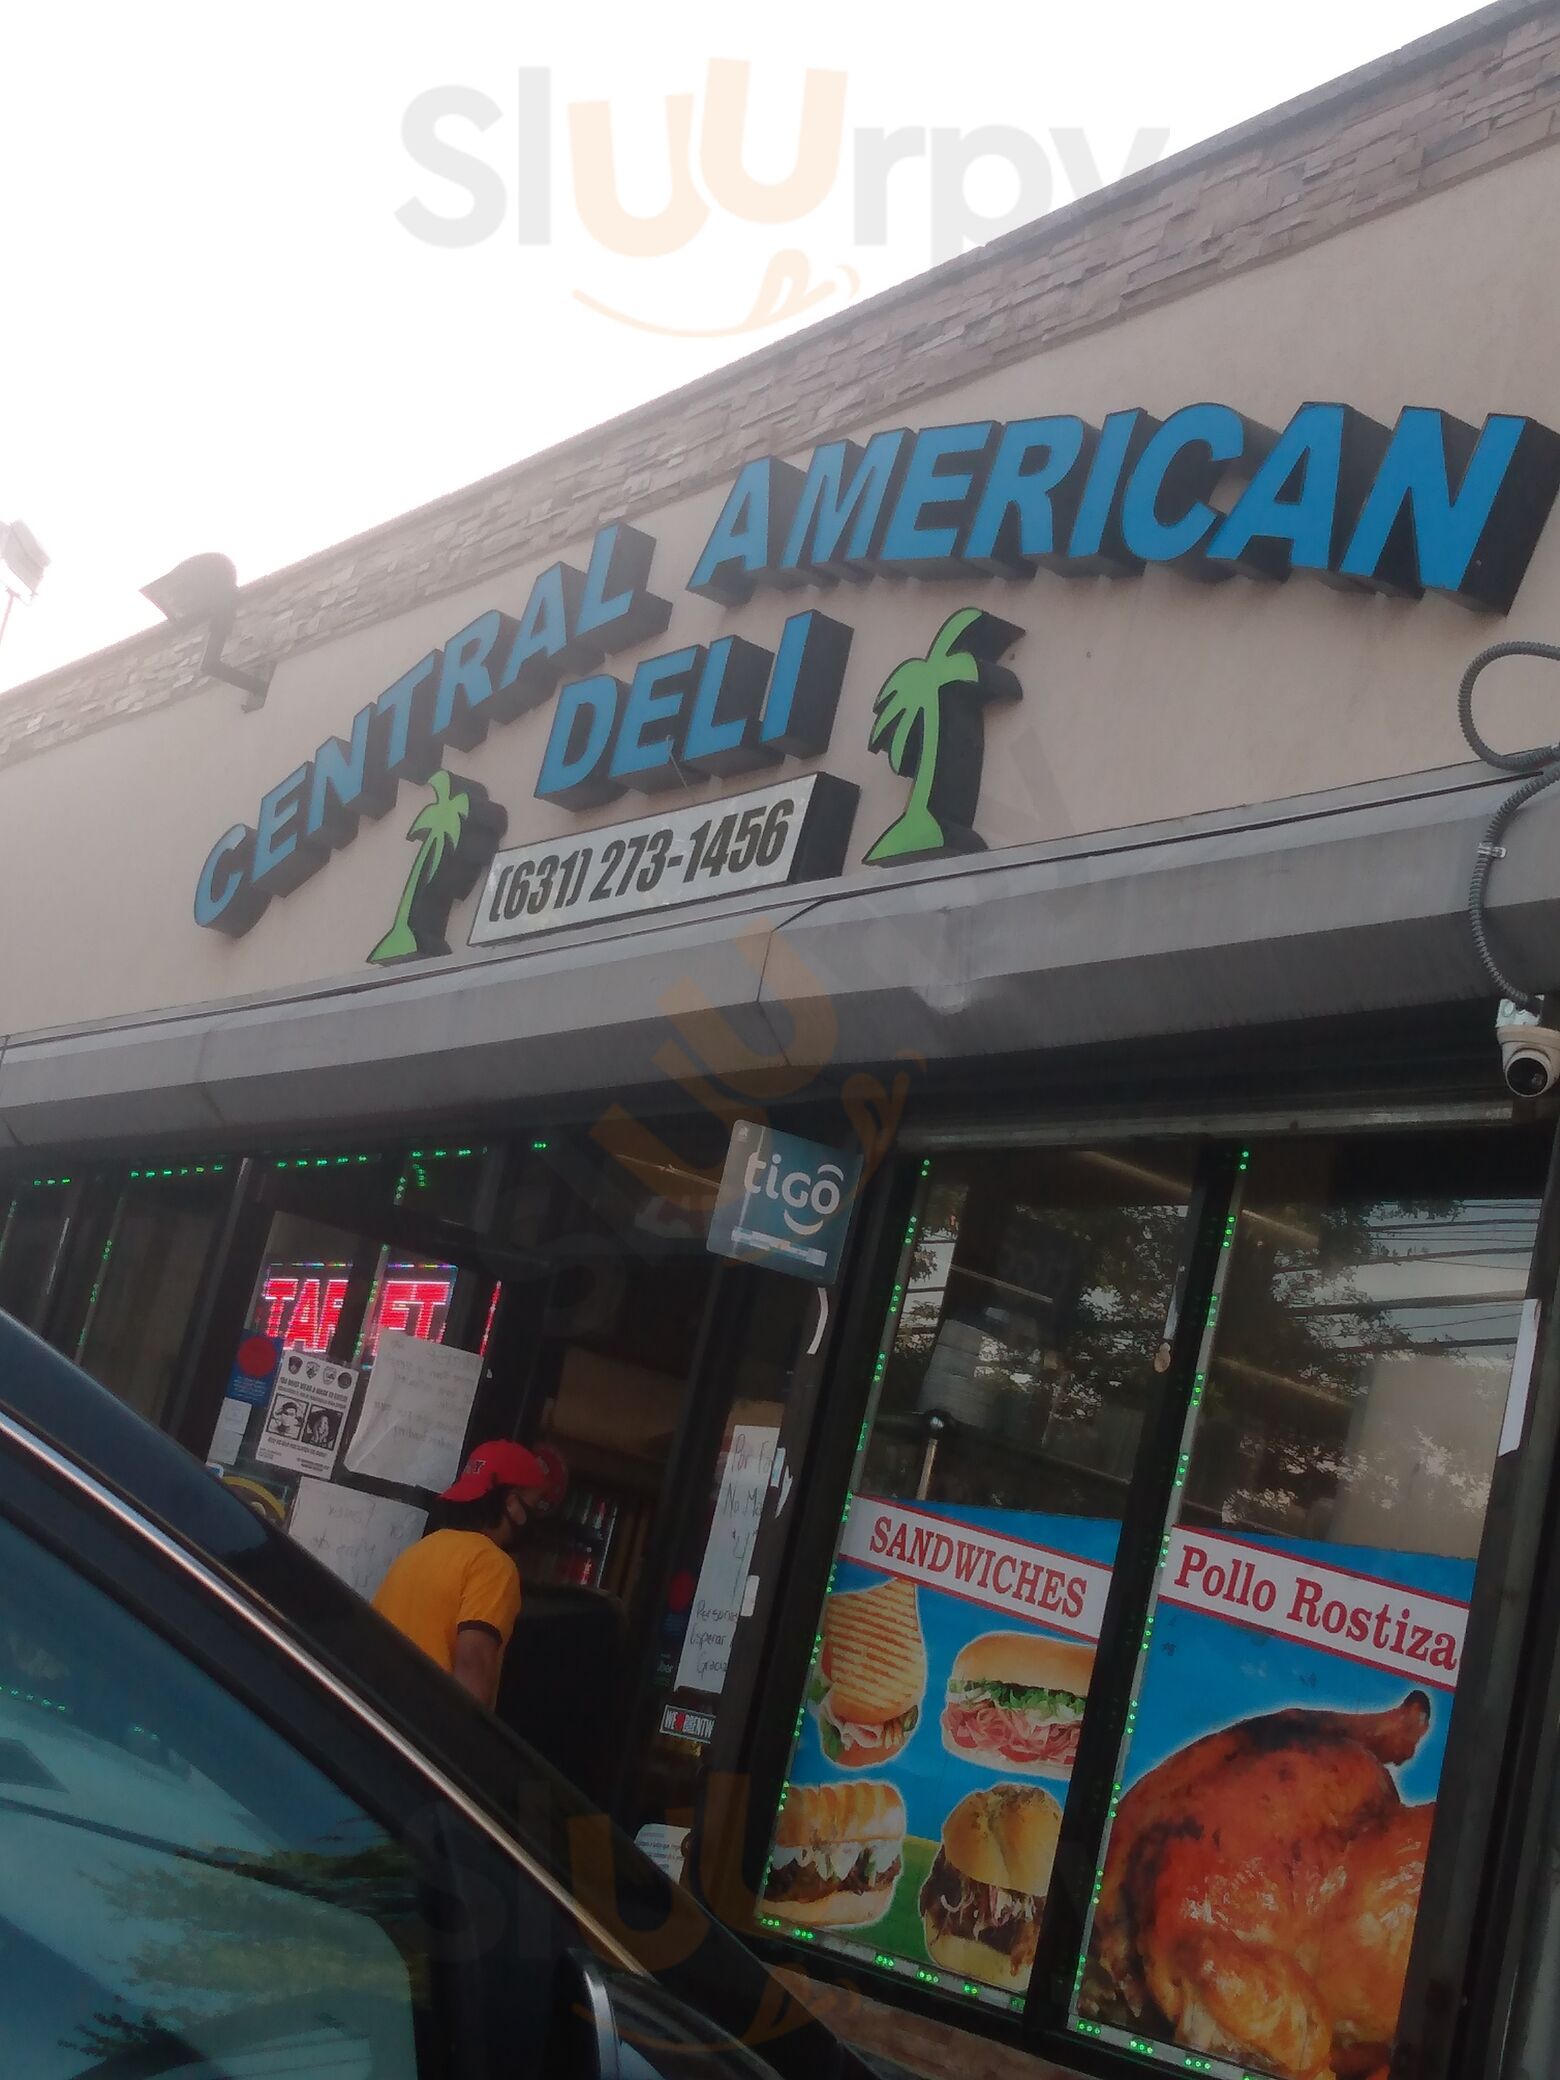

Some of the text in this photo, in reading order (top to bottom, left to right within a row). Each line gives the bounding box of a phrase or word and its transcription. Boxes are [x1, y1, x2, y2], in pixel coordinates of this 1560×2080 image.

[194, 402, 1530, 930] CENTRAL AMERICAN
[534, 609, 818, 799] DELI
[489, 799, 795, 922] (631) 273-1456
[869, 1516, 1087, 1620] SANDWICHES
[1175, 1544, 1459, 1673] Pollo Rostiza
